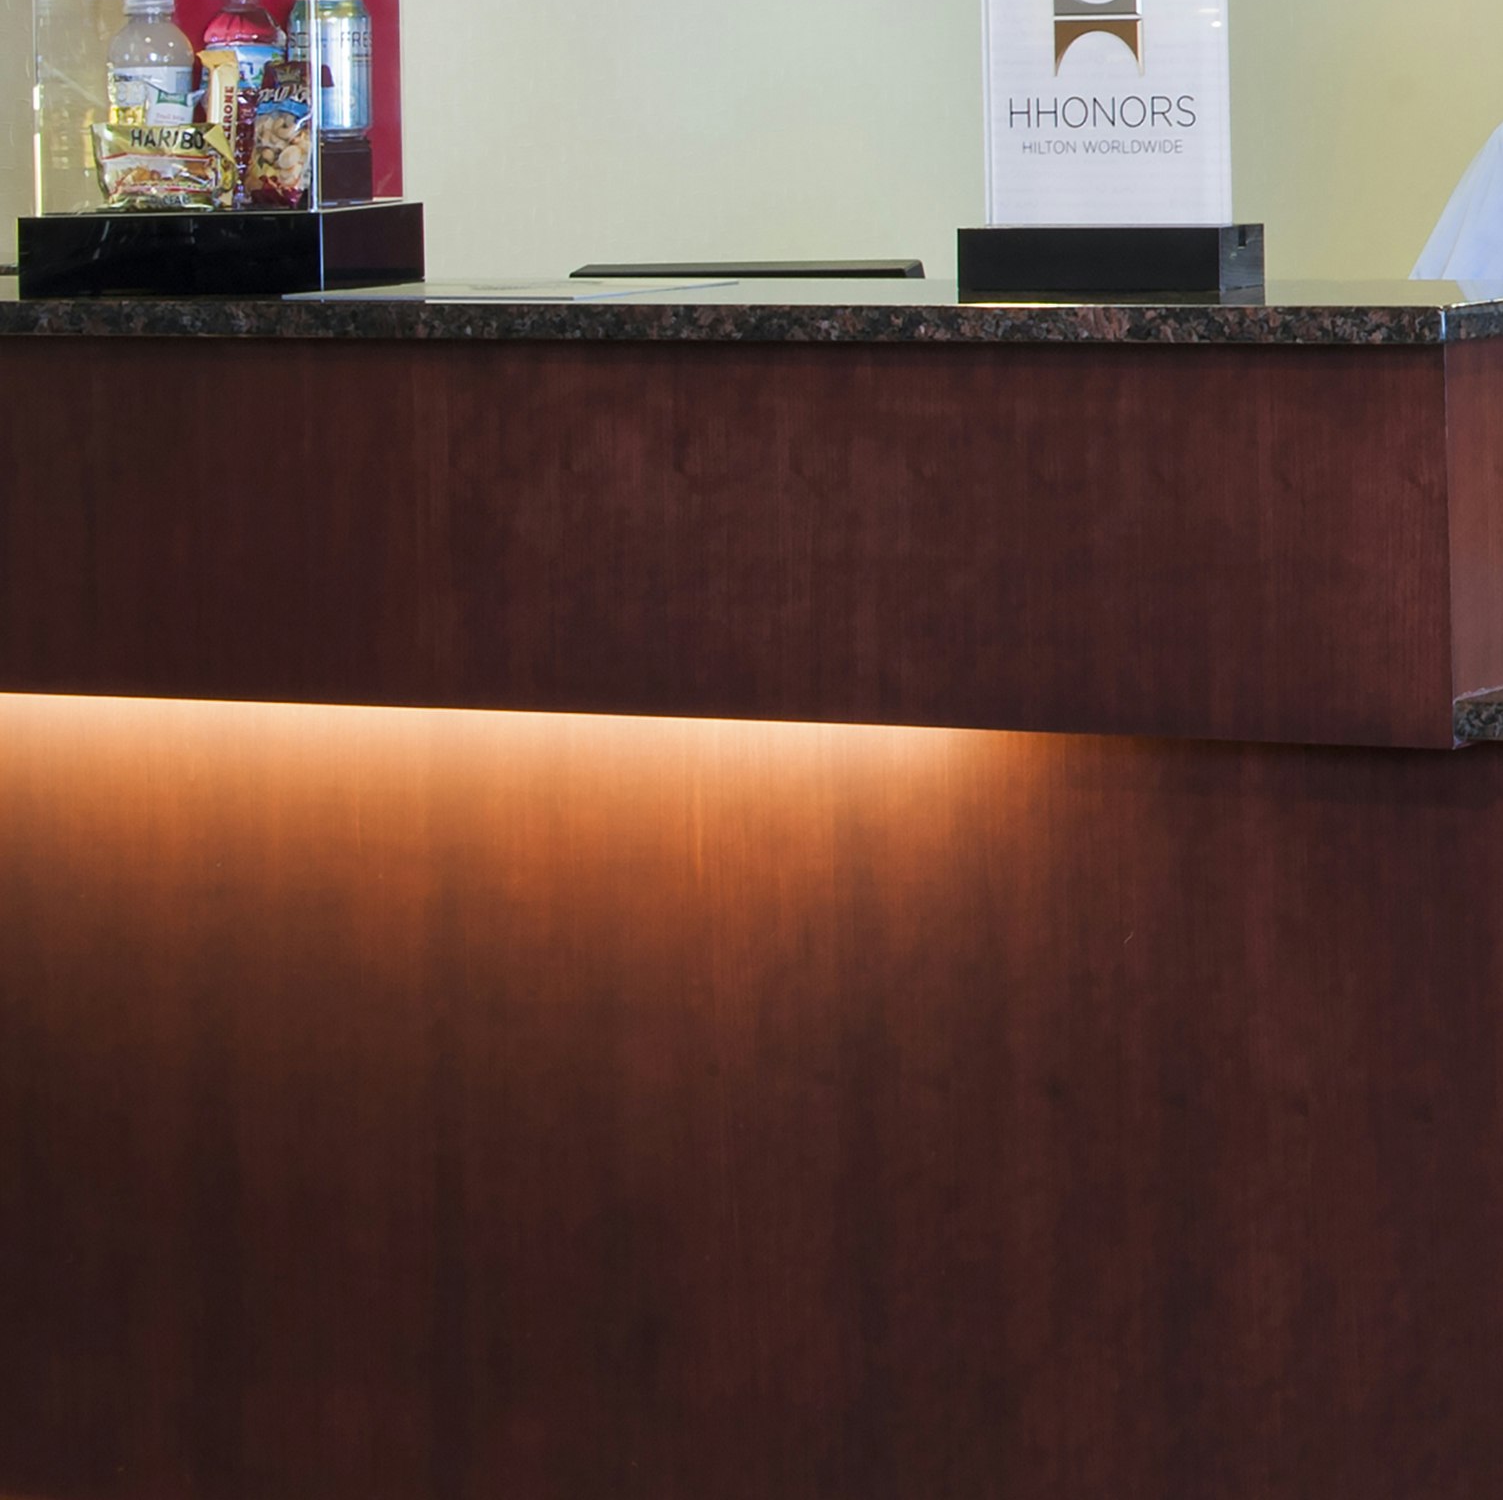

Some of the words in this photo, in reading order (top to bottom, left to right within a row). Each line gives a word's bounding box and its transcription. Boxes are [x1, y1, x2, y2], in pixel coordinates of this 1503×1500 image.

[1008, 95, 1197, 129] HHONORS
[130, 128, 205, 151] HARIBO
[1021, 140, 1078, 155] HILTON
[1082, 139, 1184, 155] WORLDWIDE
